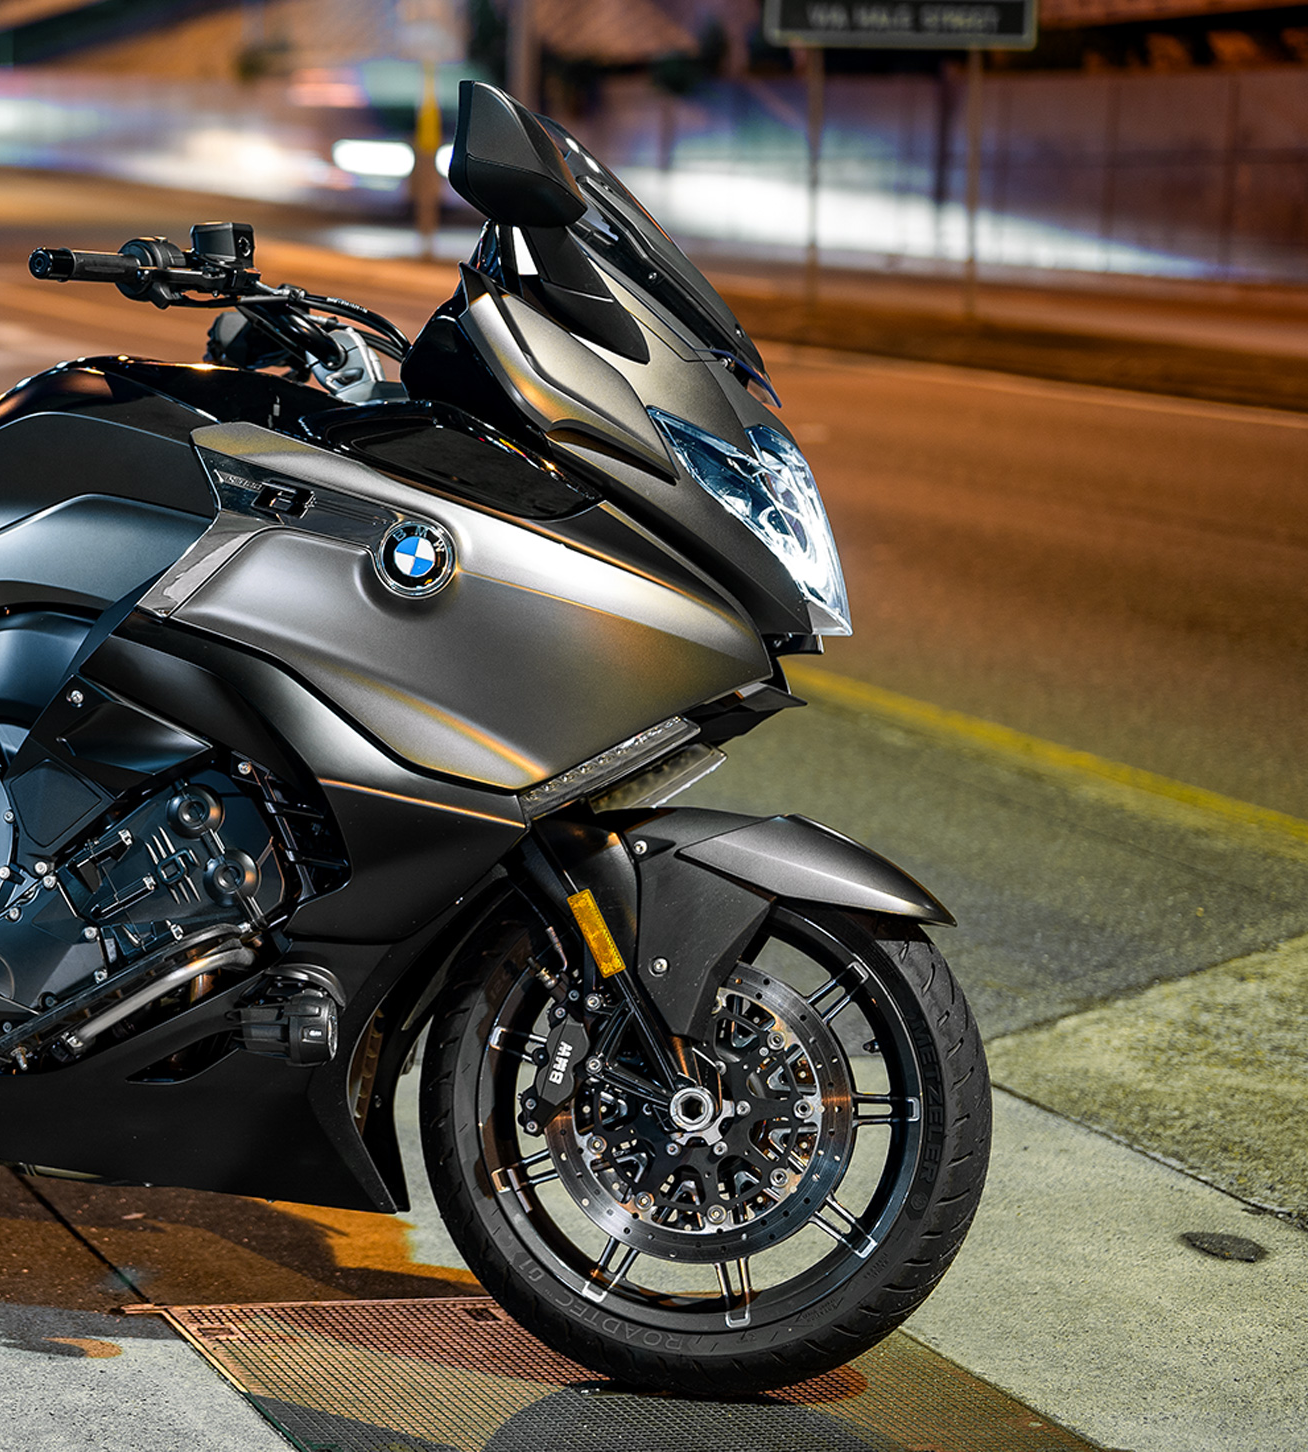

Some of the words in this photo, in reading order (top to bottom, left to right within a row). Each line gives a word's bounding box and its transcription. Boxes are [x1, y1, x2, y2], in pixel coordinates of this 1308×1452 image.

[393, 524, 447, 554] BMW
[548, 1041, 573, 1085] BMW
[913, 1022, 945, 1184] METZELER
